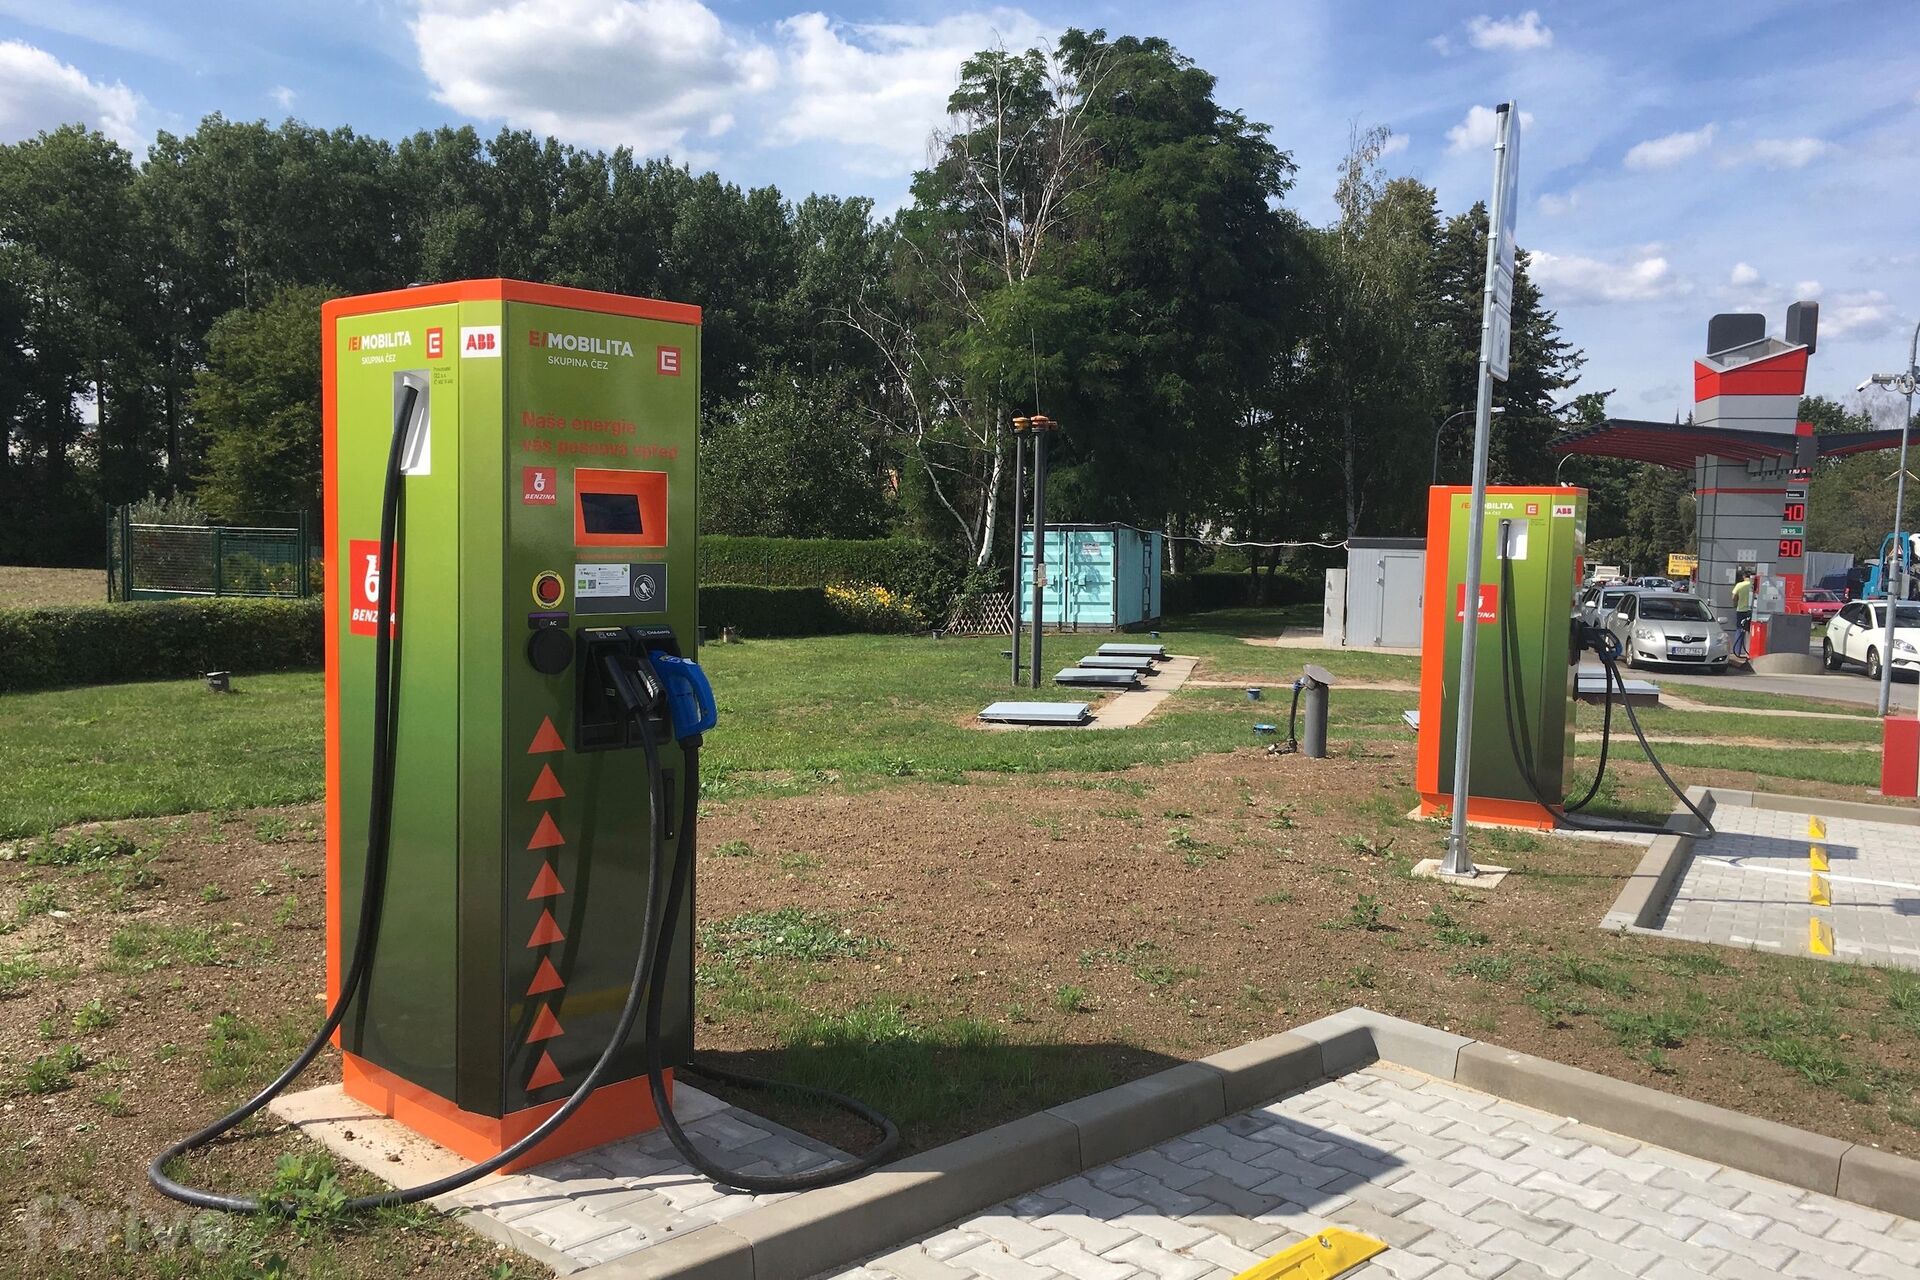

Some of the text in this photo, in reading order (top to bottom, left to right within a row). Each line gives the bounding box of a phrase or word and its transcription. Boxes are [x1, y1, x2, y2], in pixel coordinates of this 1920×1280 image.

[466, 333, 496, 351] ABB
[361, 353, 397, 365] SKUPINA ČEZ
[548, 355, 609, 370] SKUPINA ČEZ
[521, 411, 637, 437] Naše energie
[1556, 507, 1572, 515] ABB
[1780, 540, 1802, 557] 90
[352, 608, 396, 625] BENZA
